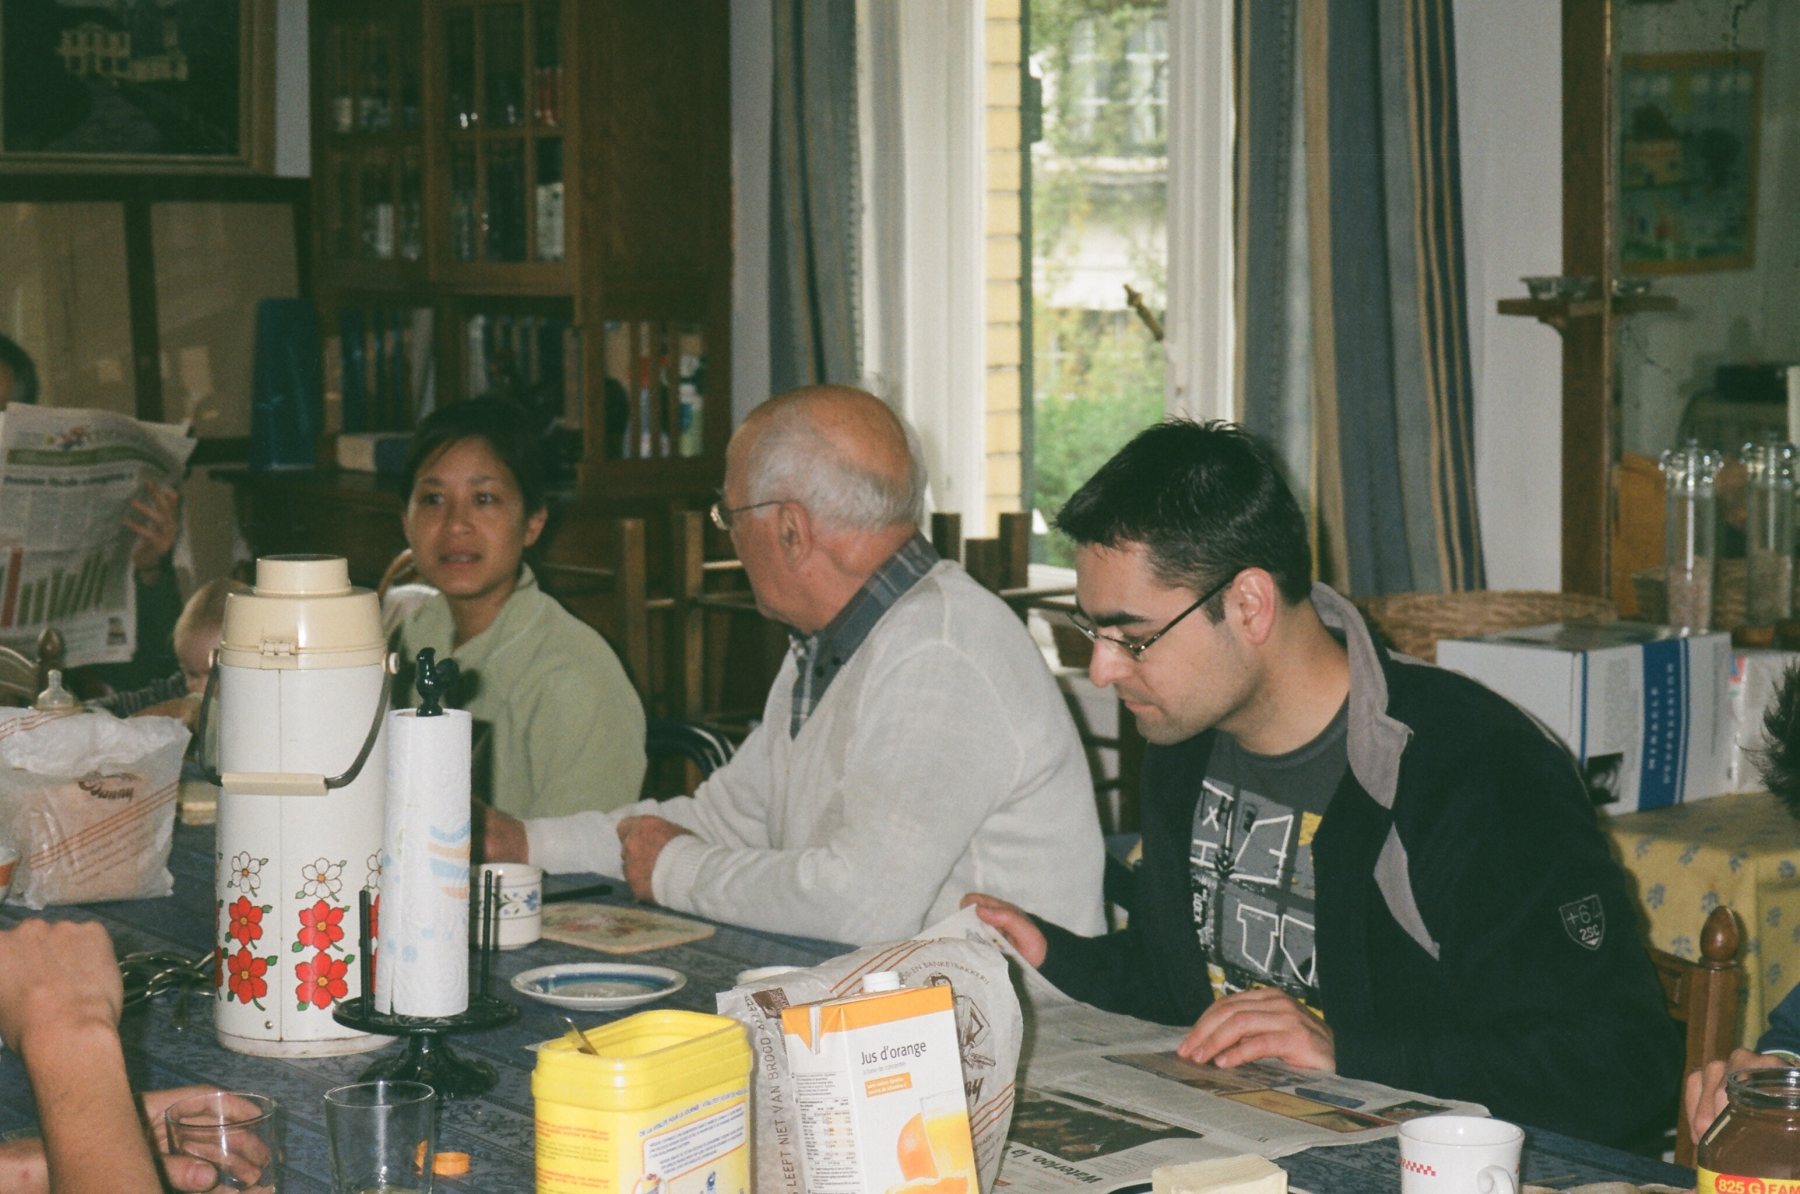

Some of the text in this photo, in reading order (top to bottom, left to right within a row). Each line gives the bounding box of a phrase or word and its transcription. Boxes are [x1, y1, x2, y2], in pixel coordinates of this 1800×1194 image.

[760, 1037, 780, 1081] BROOD
[861, 1041, 928, 1066] Jus d'orange
[770, 1085, 784, 1114] VAN
[774, 1119, 791, 1146] NIET
[780, 1150, 798, 1187] LEEFT
[1718, 1179, 1746, 1194] 825
[1748, 1182, 1761, 1194] G
